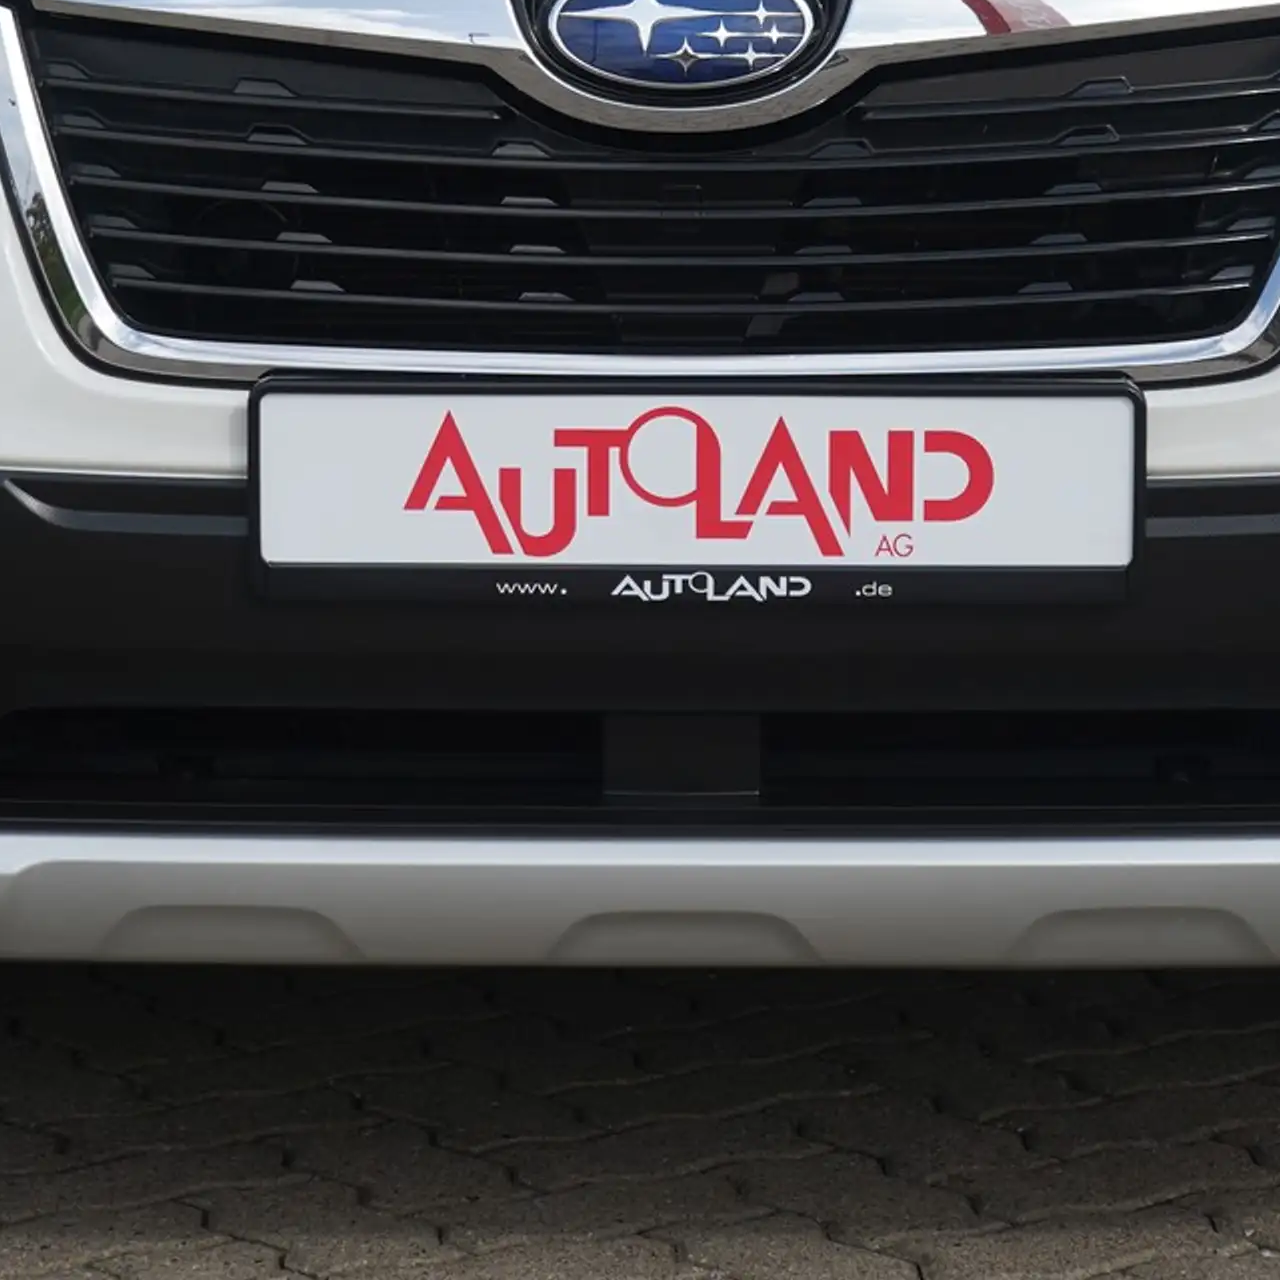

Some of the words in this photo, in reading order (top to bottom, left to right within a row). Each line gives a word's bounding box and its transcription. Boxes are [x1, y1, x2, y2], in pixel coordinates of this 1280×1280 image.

[404, 406, 994, 557] AUTOLAND
[875, 534, 914, 557] AG
[496, 581, 567, 595] www.
[611, 571, 812, 602] AUTOLAND
[855, 581, 893, 597] .de
